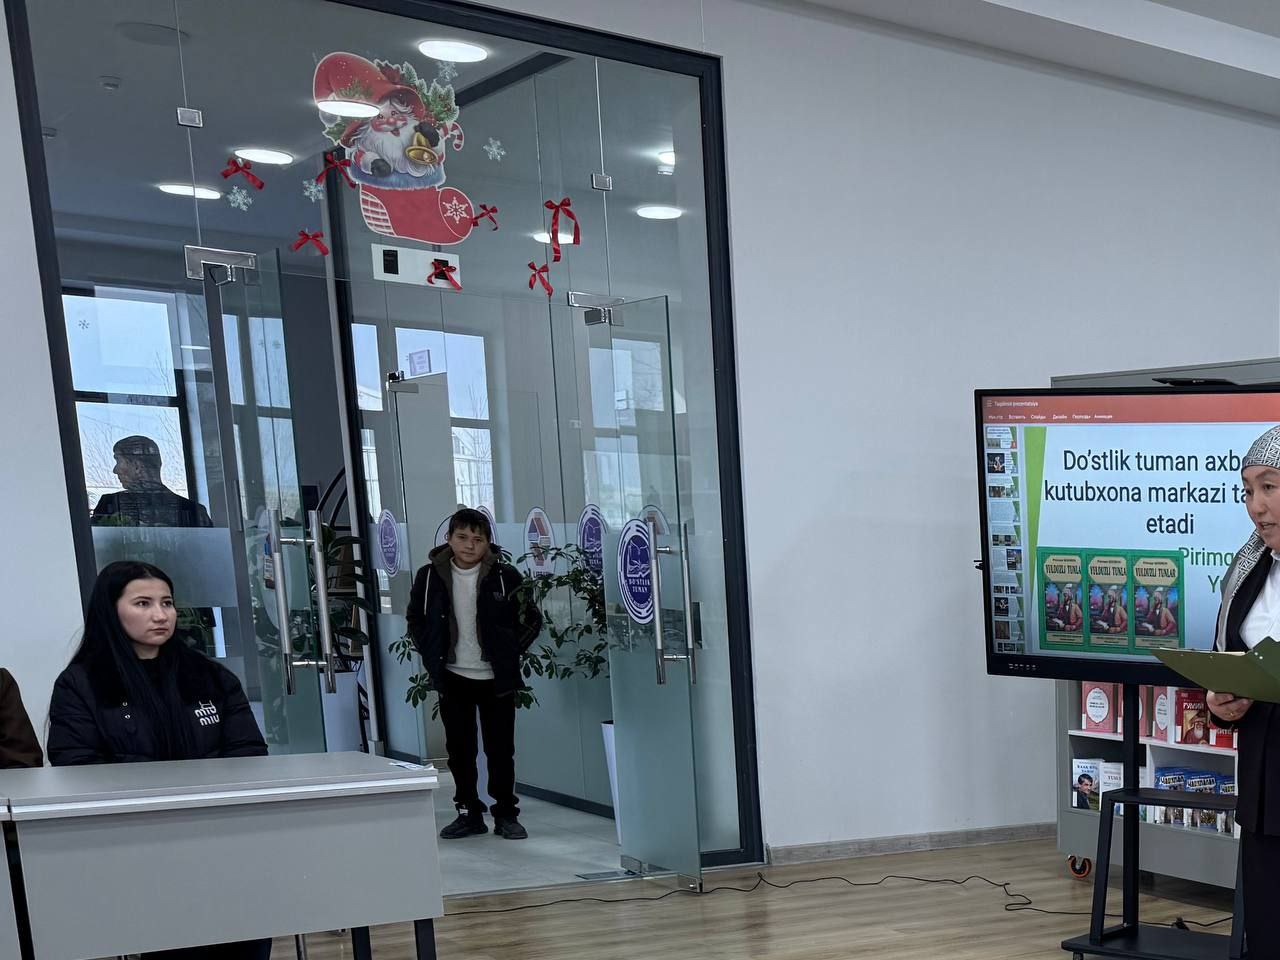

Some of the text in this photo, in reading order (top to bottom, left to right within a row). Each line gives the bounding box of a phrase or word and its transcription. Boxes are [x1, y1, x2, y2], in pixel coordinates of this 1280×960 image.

[1064, 450, 1243, 471] Do'stlik tuman axb
[1045, 480, 1247, 504] kutubxona markazi ta
[1146, 513, 1194, 534] etadi
[1208, 575, 1221, 593] Y
